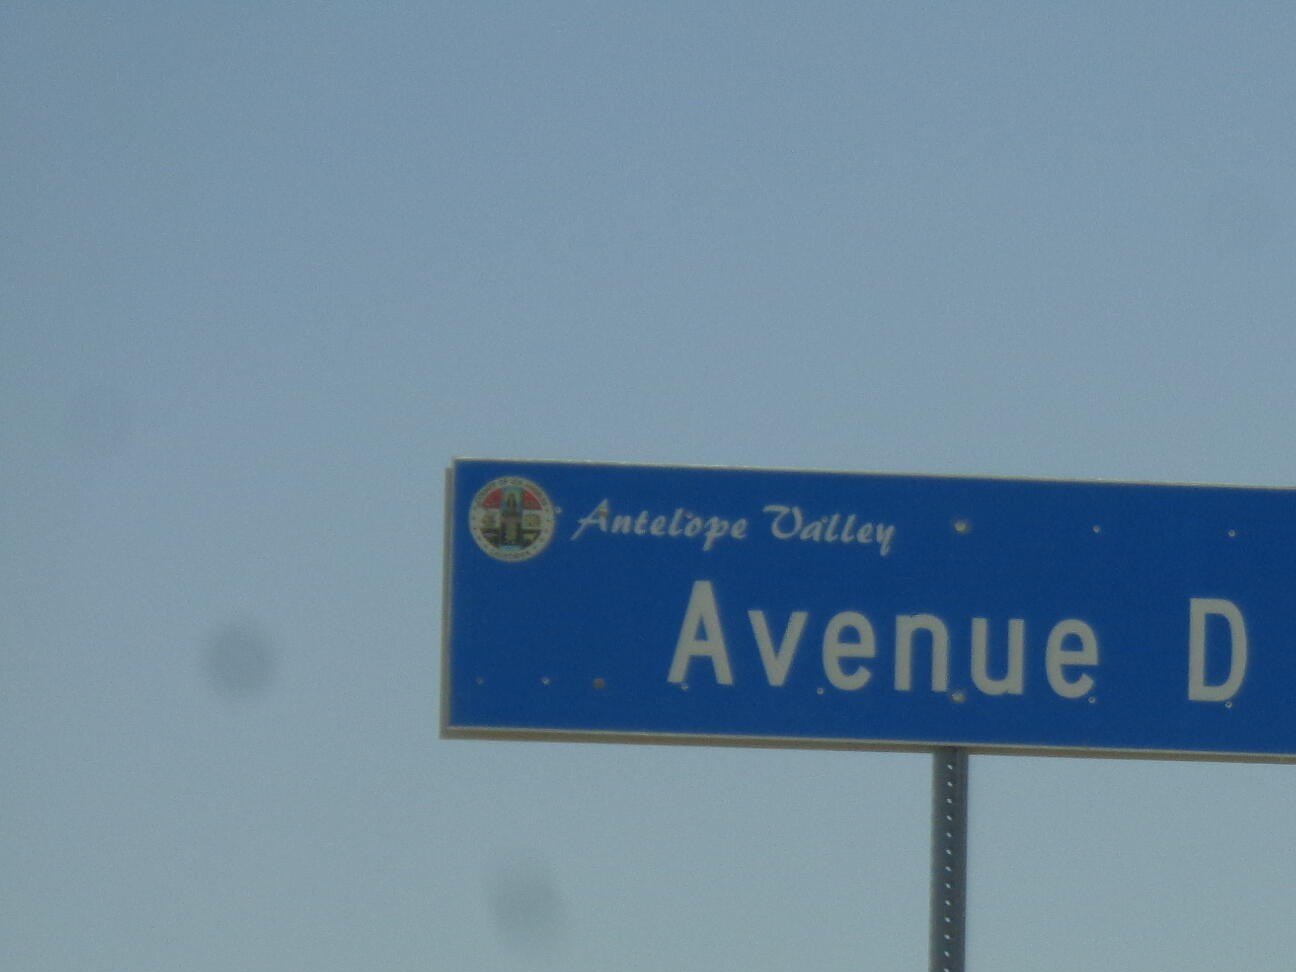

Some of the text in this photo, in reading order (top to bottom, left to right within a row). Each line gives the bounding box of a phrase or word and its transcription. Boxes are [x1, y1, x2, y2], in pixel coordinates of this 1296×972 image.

[570, 499, 748, 551] Antelope
[762, 505, 896, 556] Valley
[667, 580, 1248, 702] Avenue D
